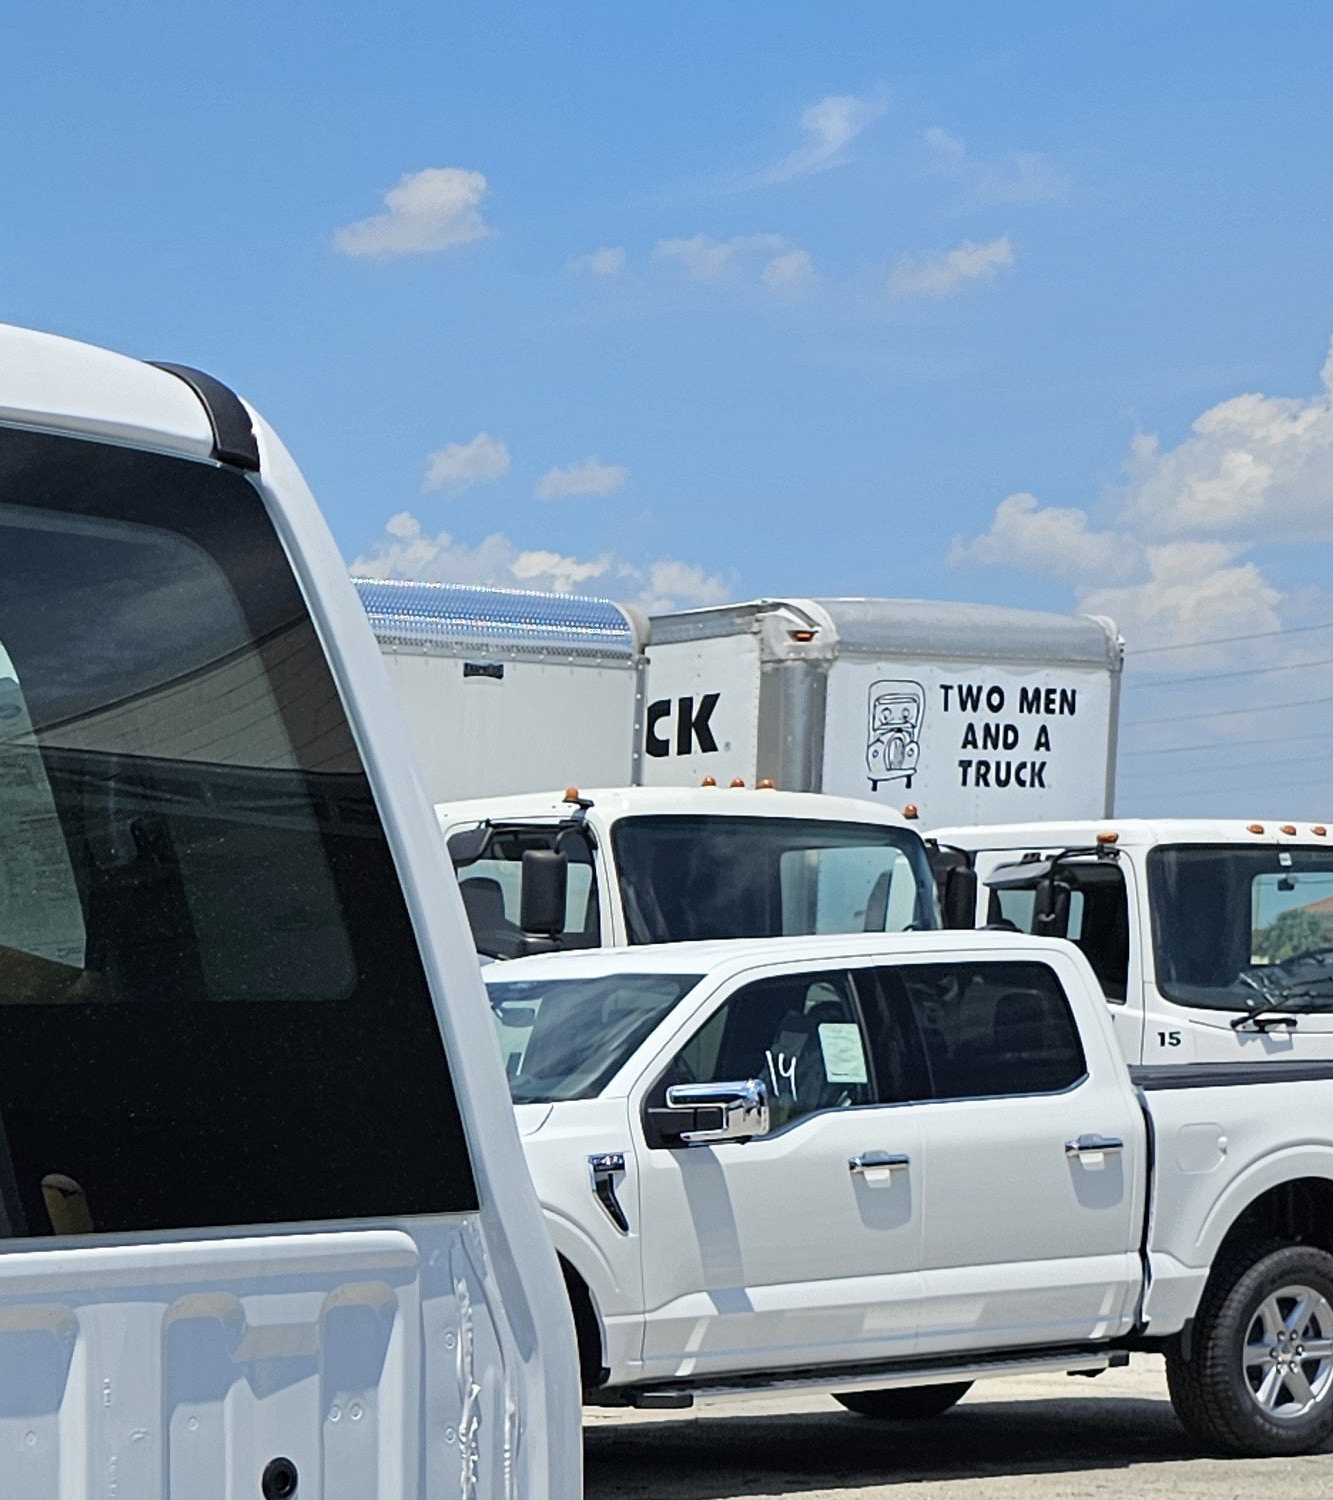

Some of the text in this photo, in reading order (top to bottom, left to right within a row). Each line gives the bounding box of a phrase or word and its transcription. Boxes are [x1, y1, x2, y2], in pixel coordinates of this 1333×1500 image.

[939, 684, 1077, 717] TWO MEN
[961, 723, 1052, 752] AND A
[958, 760, 1047, 789] TRUCK
[1157, 1031, 1181, 1047] 15
